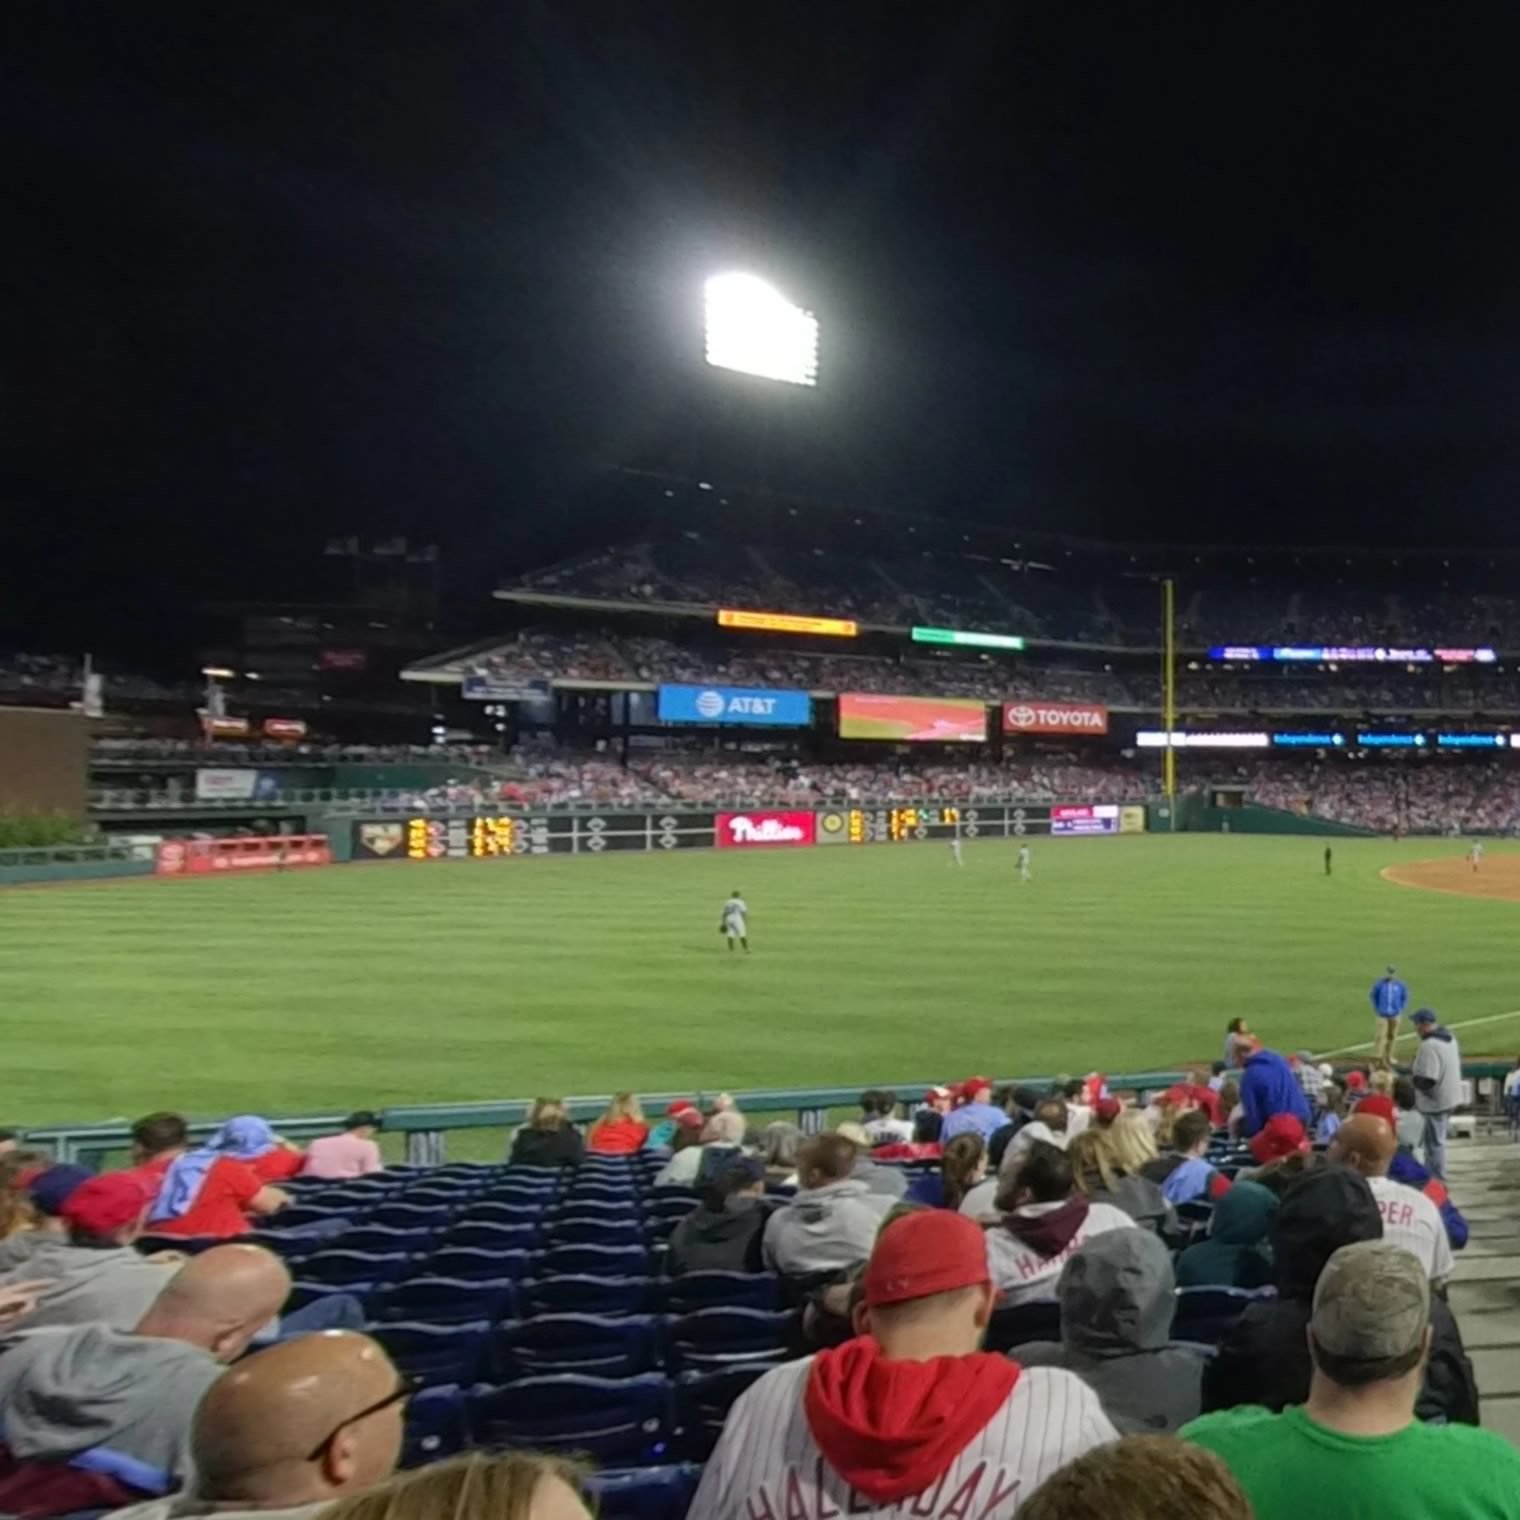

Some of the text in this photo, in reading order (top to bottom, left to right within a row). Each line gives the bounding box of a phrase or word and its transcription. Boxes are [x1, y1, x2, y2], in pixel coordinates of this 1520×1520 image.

[728, 697, 776, 714] AT&T
[1037, 709, 1103, 727] TOYOTA
[1376, 1201, 1413, 1226] PER
[748, 1455, 1021, 1520] HALLDAY
